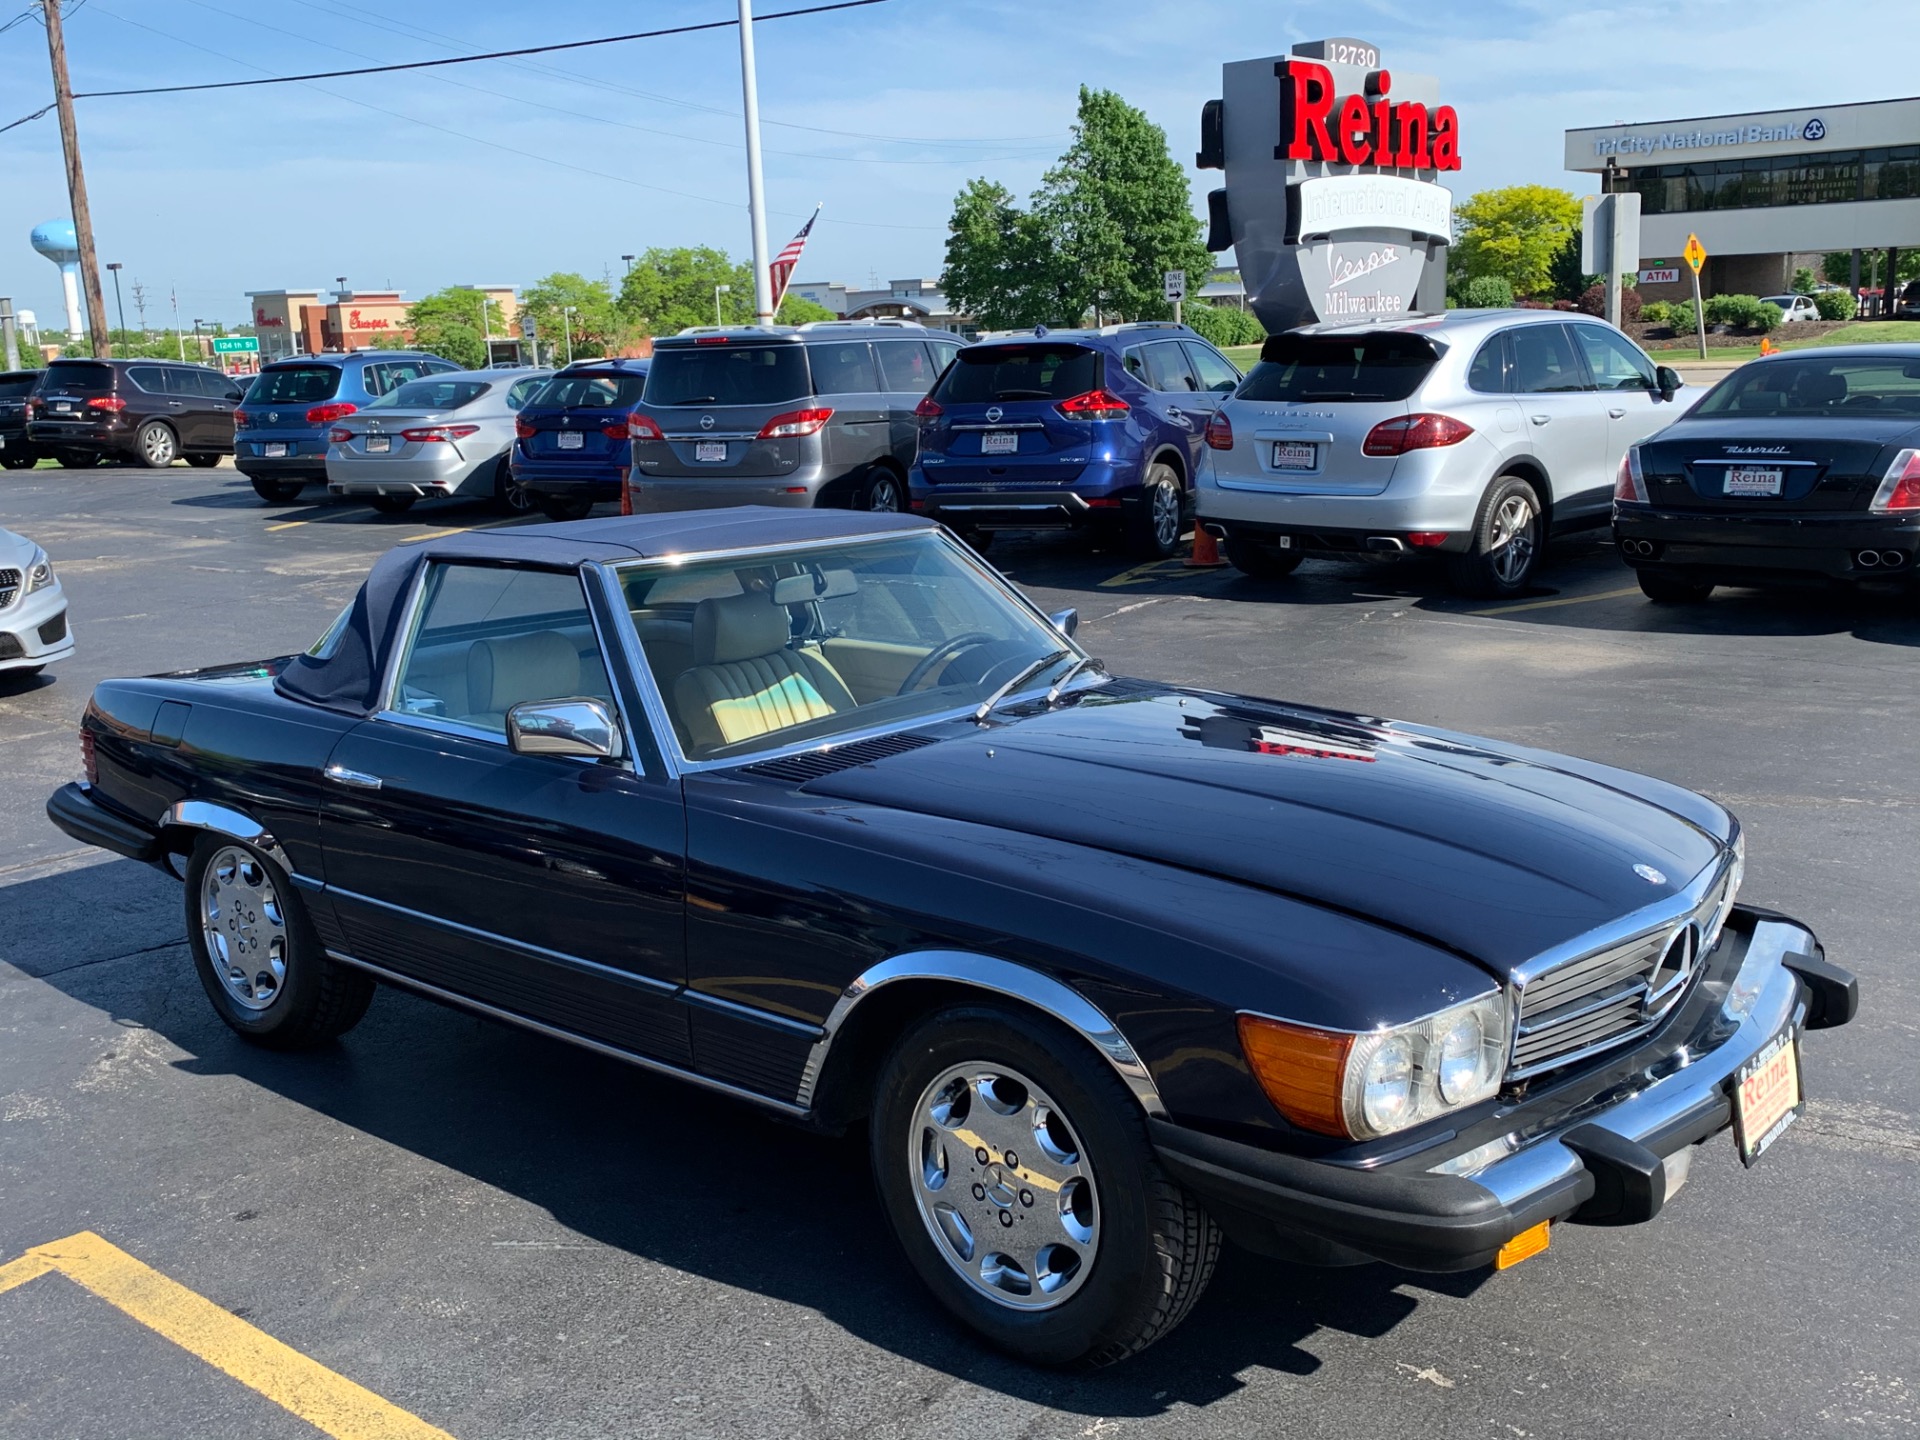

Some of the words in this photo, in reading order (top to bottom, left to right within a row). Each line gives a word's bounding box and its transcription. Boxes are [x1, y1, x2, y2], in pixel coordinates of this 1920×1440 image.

[1330, 44, 1375, 67] 12730
[1288, 60, 1461, 171] Reina
[1593, 136, 1656, 156] TriCity
[1658, 127, 1743, 150] National
[1749, 123, 1800, 143] Bank
[1306, 184, 1408, 223] International
[1412, 189, 1448, 229] Auto
[1326, 243, 1399, 289] Vespa
[1168, 273, 1182, 281] ONE
[1646, 271, 1672, 281] ATM
[1325, 290, 1400, 315] Milwaukee
[700, 444, 724, 452] Reina
[985, 435, 1014, 445] Reina
[1279, 447, 1311, 457] Reina
[1722, 446, 1790, 454] Maserati
[1730, 471, 1776, 483] Reina
[1743, 1055, 1789, 1112] Reina
